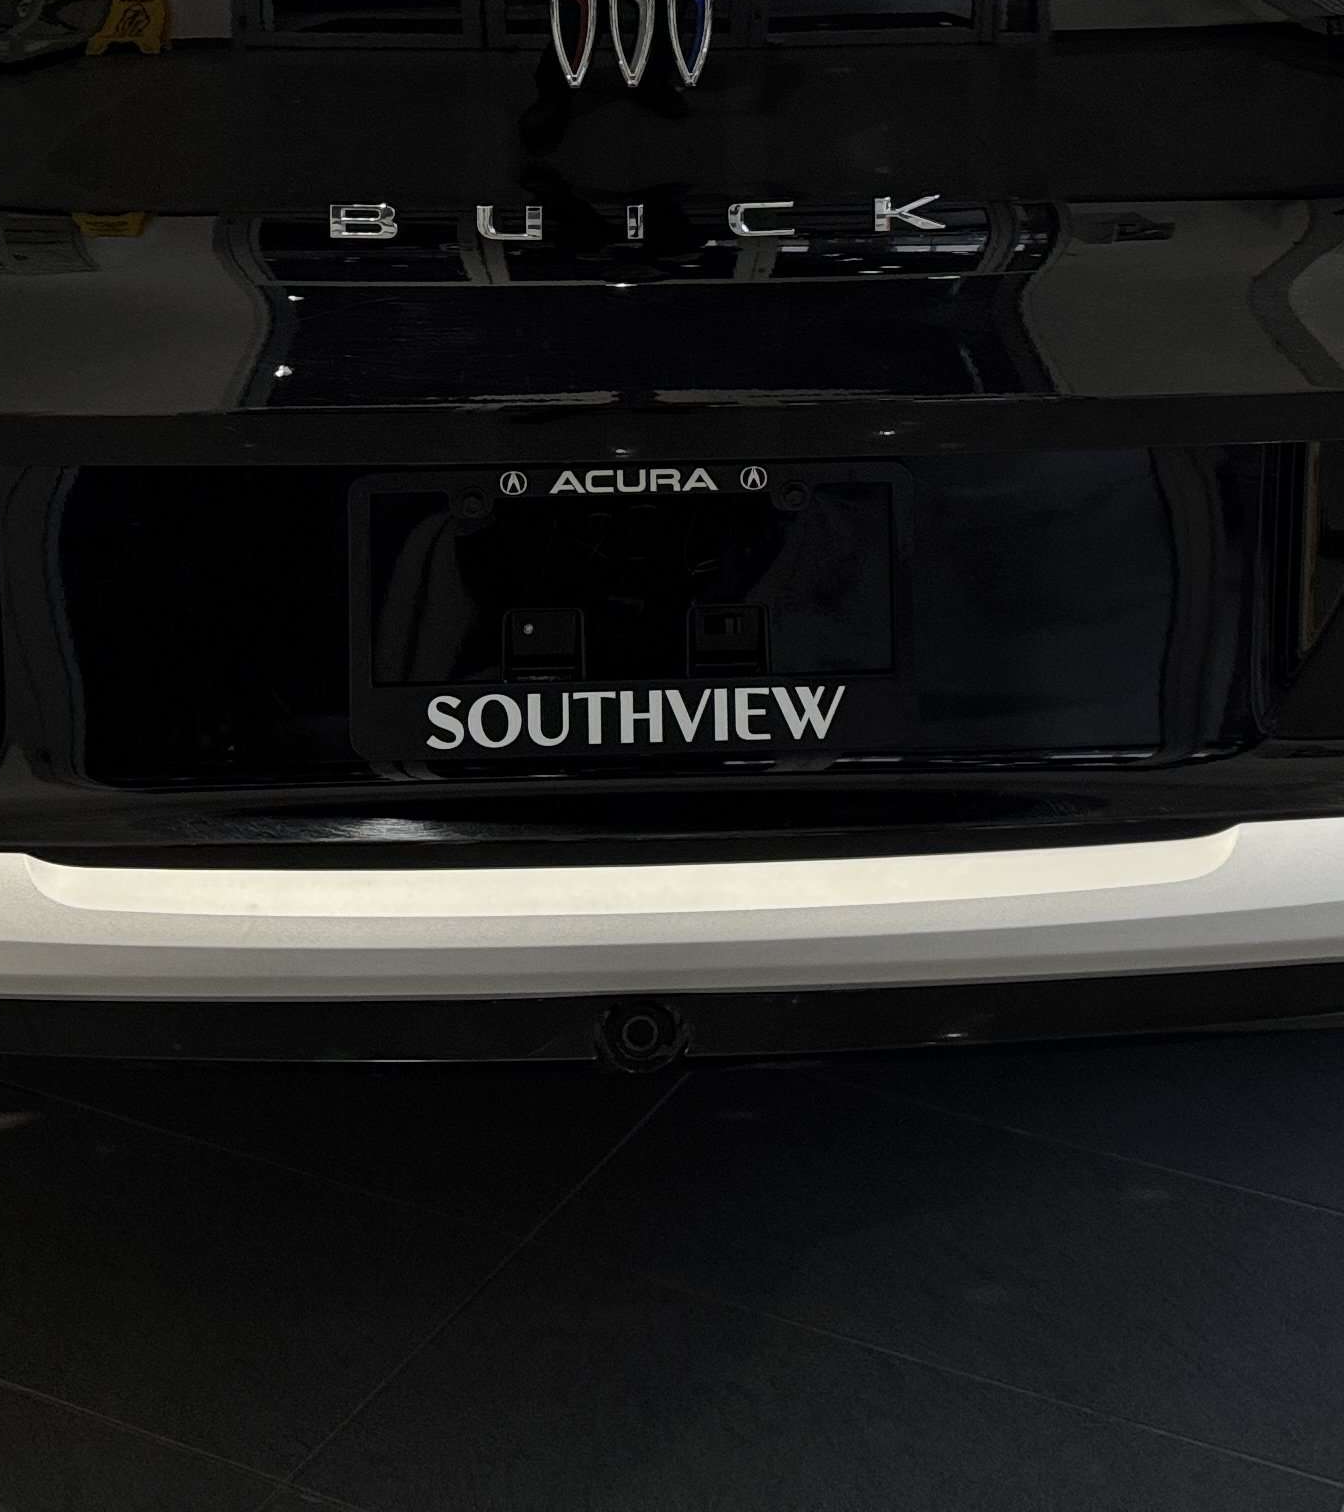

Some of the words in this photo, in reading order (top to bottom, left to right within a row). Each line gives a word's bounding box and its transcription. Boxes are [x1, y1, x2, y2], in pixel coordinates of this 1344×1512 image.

[329, 193, 947, 241] BUICK
[549, 467, 719, 494] ACURA
[426, 685, 847, 751] SOUTHVIEW
